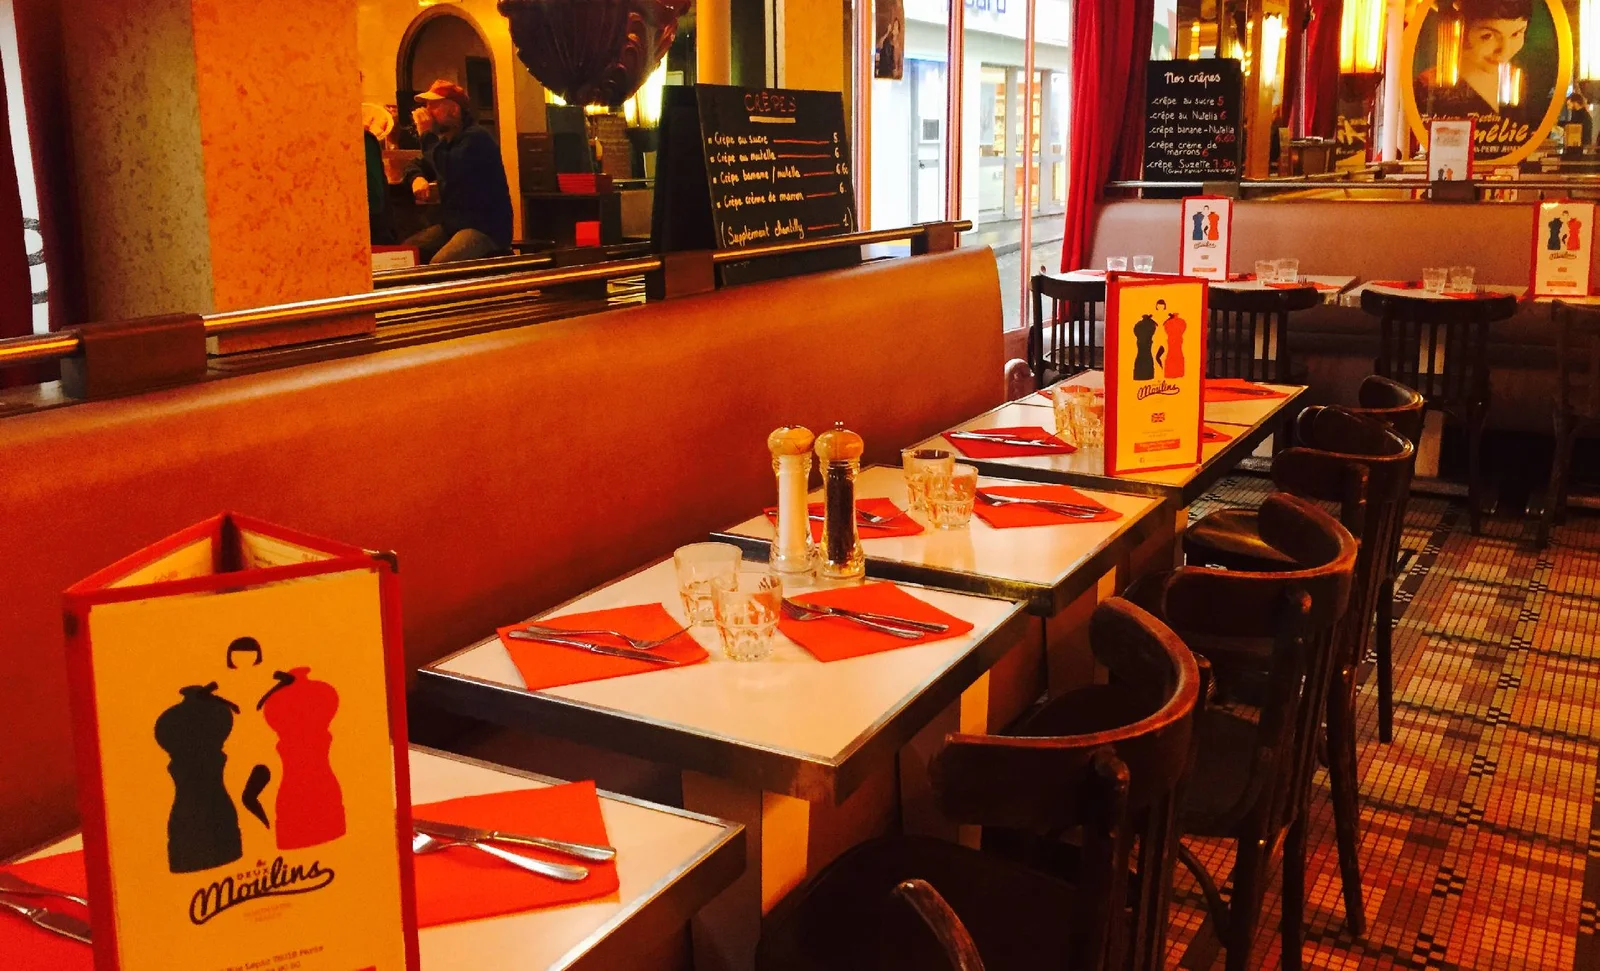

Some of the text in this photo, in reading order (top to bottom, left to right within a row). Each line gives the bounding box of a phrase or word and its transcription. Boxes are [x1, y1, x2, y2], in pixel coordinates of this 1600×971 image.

[1164, 71, 1221, 89] Nos crêpes
[744, 91, 797, 113] CRÊPES
[1151, 96, 1177, 108] crêpe
[1183, 97, 1192, 105] au
[1217, 96, 1224, 107] 5
[1150, 111, 1175, 124] crêpe
[1178, 112, 1188, 120] au
[1191, 110, 1218, 121] Nutella
[1149, 125, 1174, 138] crêpe
[749, 135, 768, 145] sucre
[1148, 141, 1174, 153] crêpe
[1207, 141, 1218, 149] de
[1167, 148, 1209, 157] marrons 6
[1147, 159, 1173, 172] crêpe
[1178, 159, 1211, 169] Suzette
[742, 169, 769, 181] banane
[1137, 380, 1181, 401] Moulins
[237, 868, 270, 881] DEUX
[189, 855, 335, 926] Moulins
